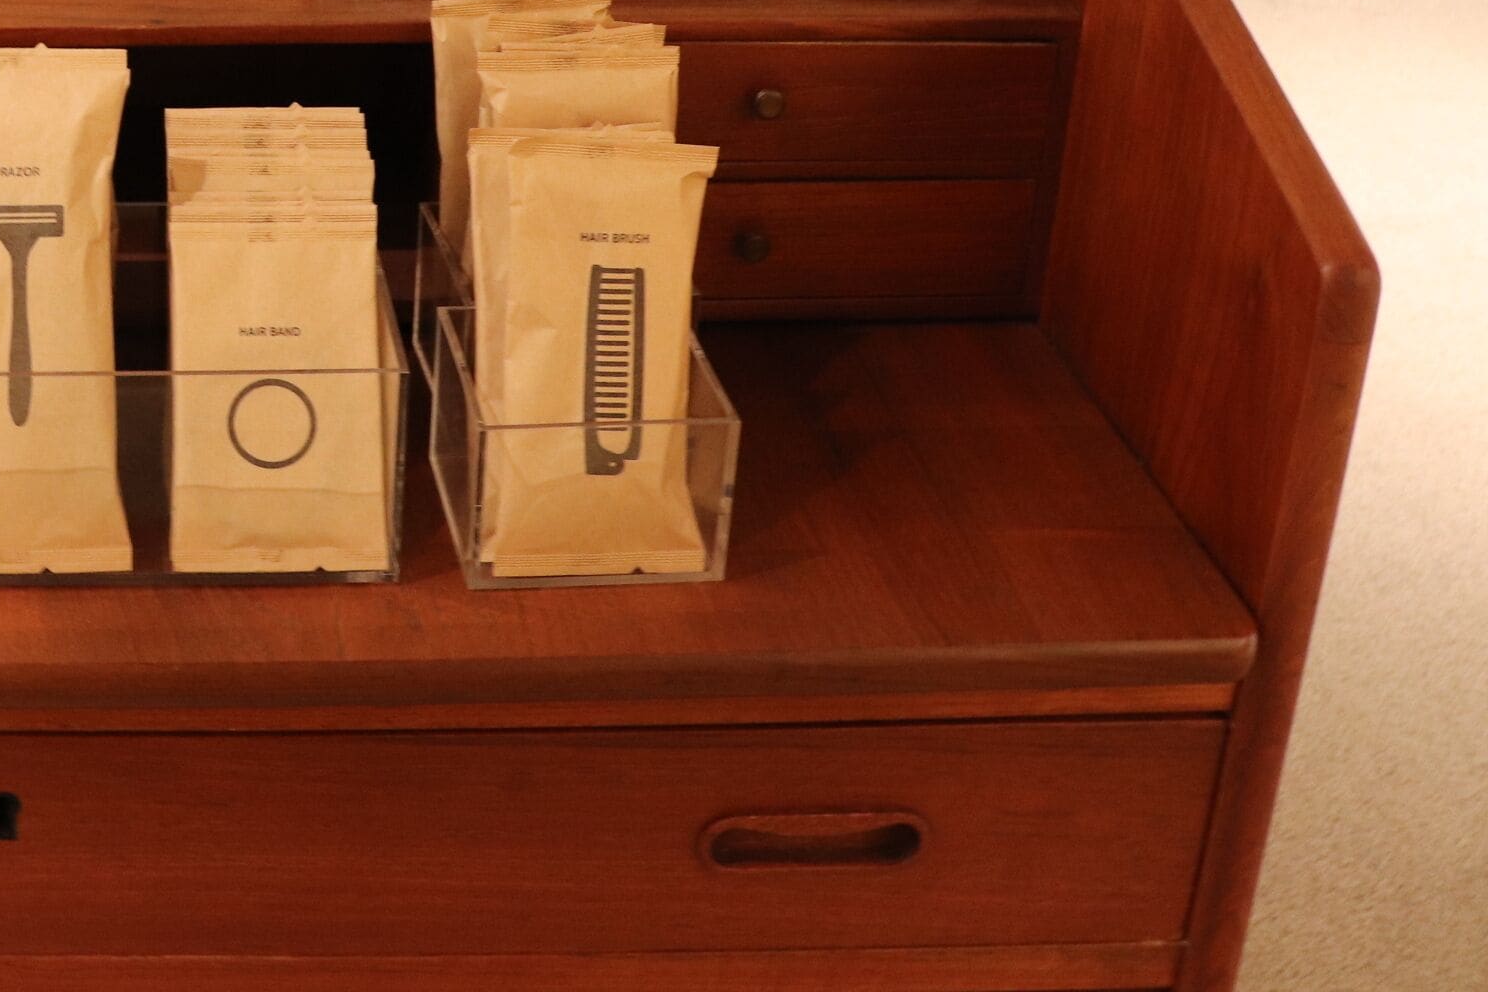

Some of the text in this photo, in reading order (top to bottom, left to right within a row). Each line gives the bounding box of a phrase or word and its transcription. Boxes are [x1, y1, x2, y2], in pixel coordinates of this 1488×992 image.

[0, 166, 41, 177] RAZOR
[579, 232, 650, 244] HAIR BRUSH
[239, 326, 301, 337] HAIR BAND
